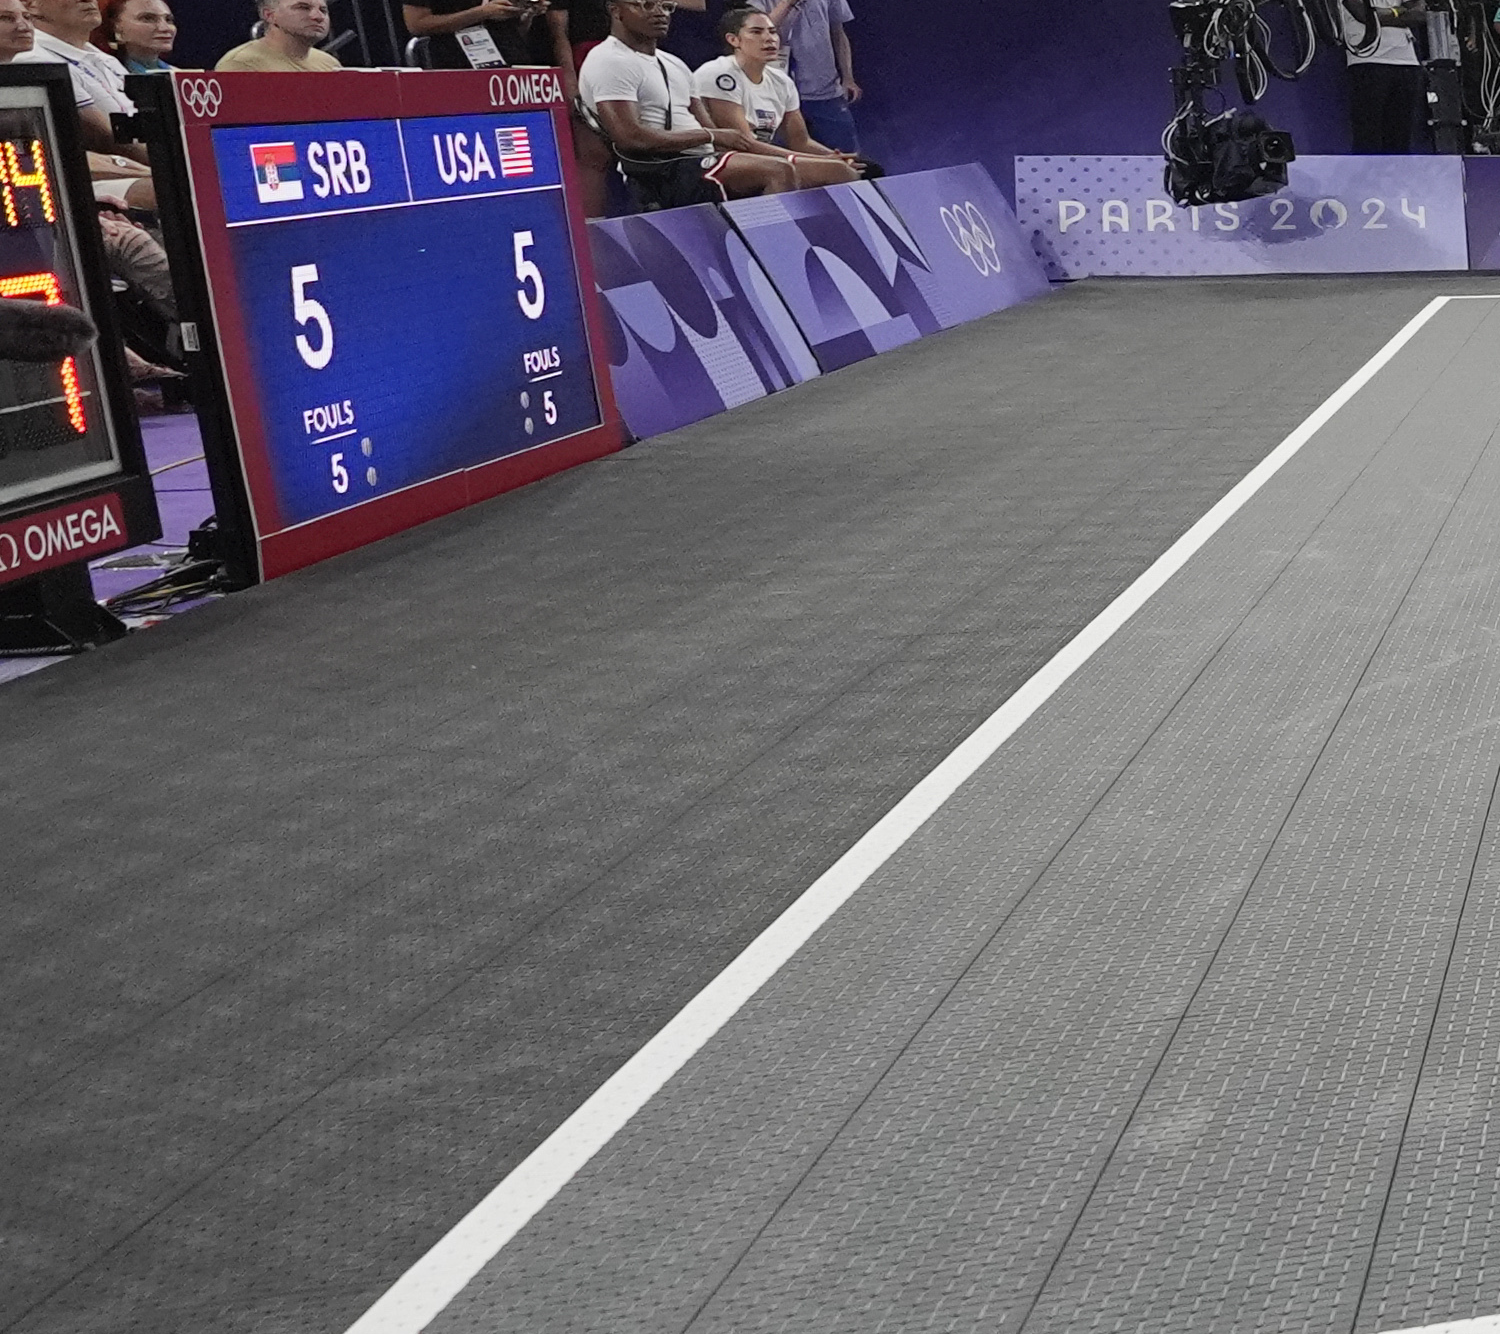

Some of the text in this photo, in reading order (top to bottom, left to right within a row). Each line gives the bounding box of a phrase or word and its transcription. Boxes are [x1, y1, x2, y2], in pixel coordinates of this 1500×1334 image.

[507, 74, 565, 106] OMEGA
[307, 131, 495, 198] SRB USA
[1058, 197, 1426, 233] PARIS 2024
[513, 230, 545, 321] 5
[290, 263, 334, 371] 5
[523, 345, 561, 374] FOULS
[303, 399, 355, 435] FOULS
[543, 390, 558, 426] 5
[331, 452, 349, 495] 5
[24, 503, 121, 562] OMEGA
